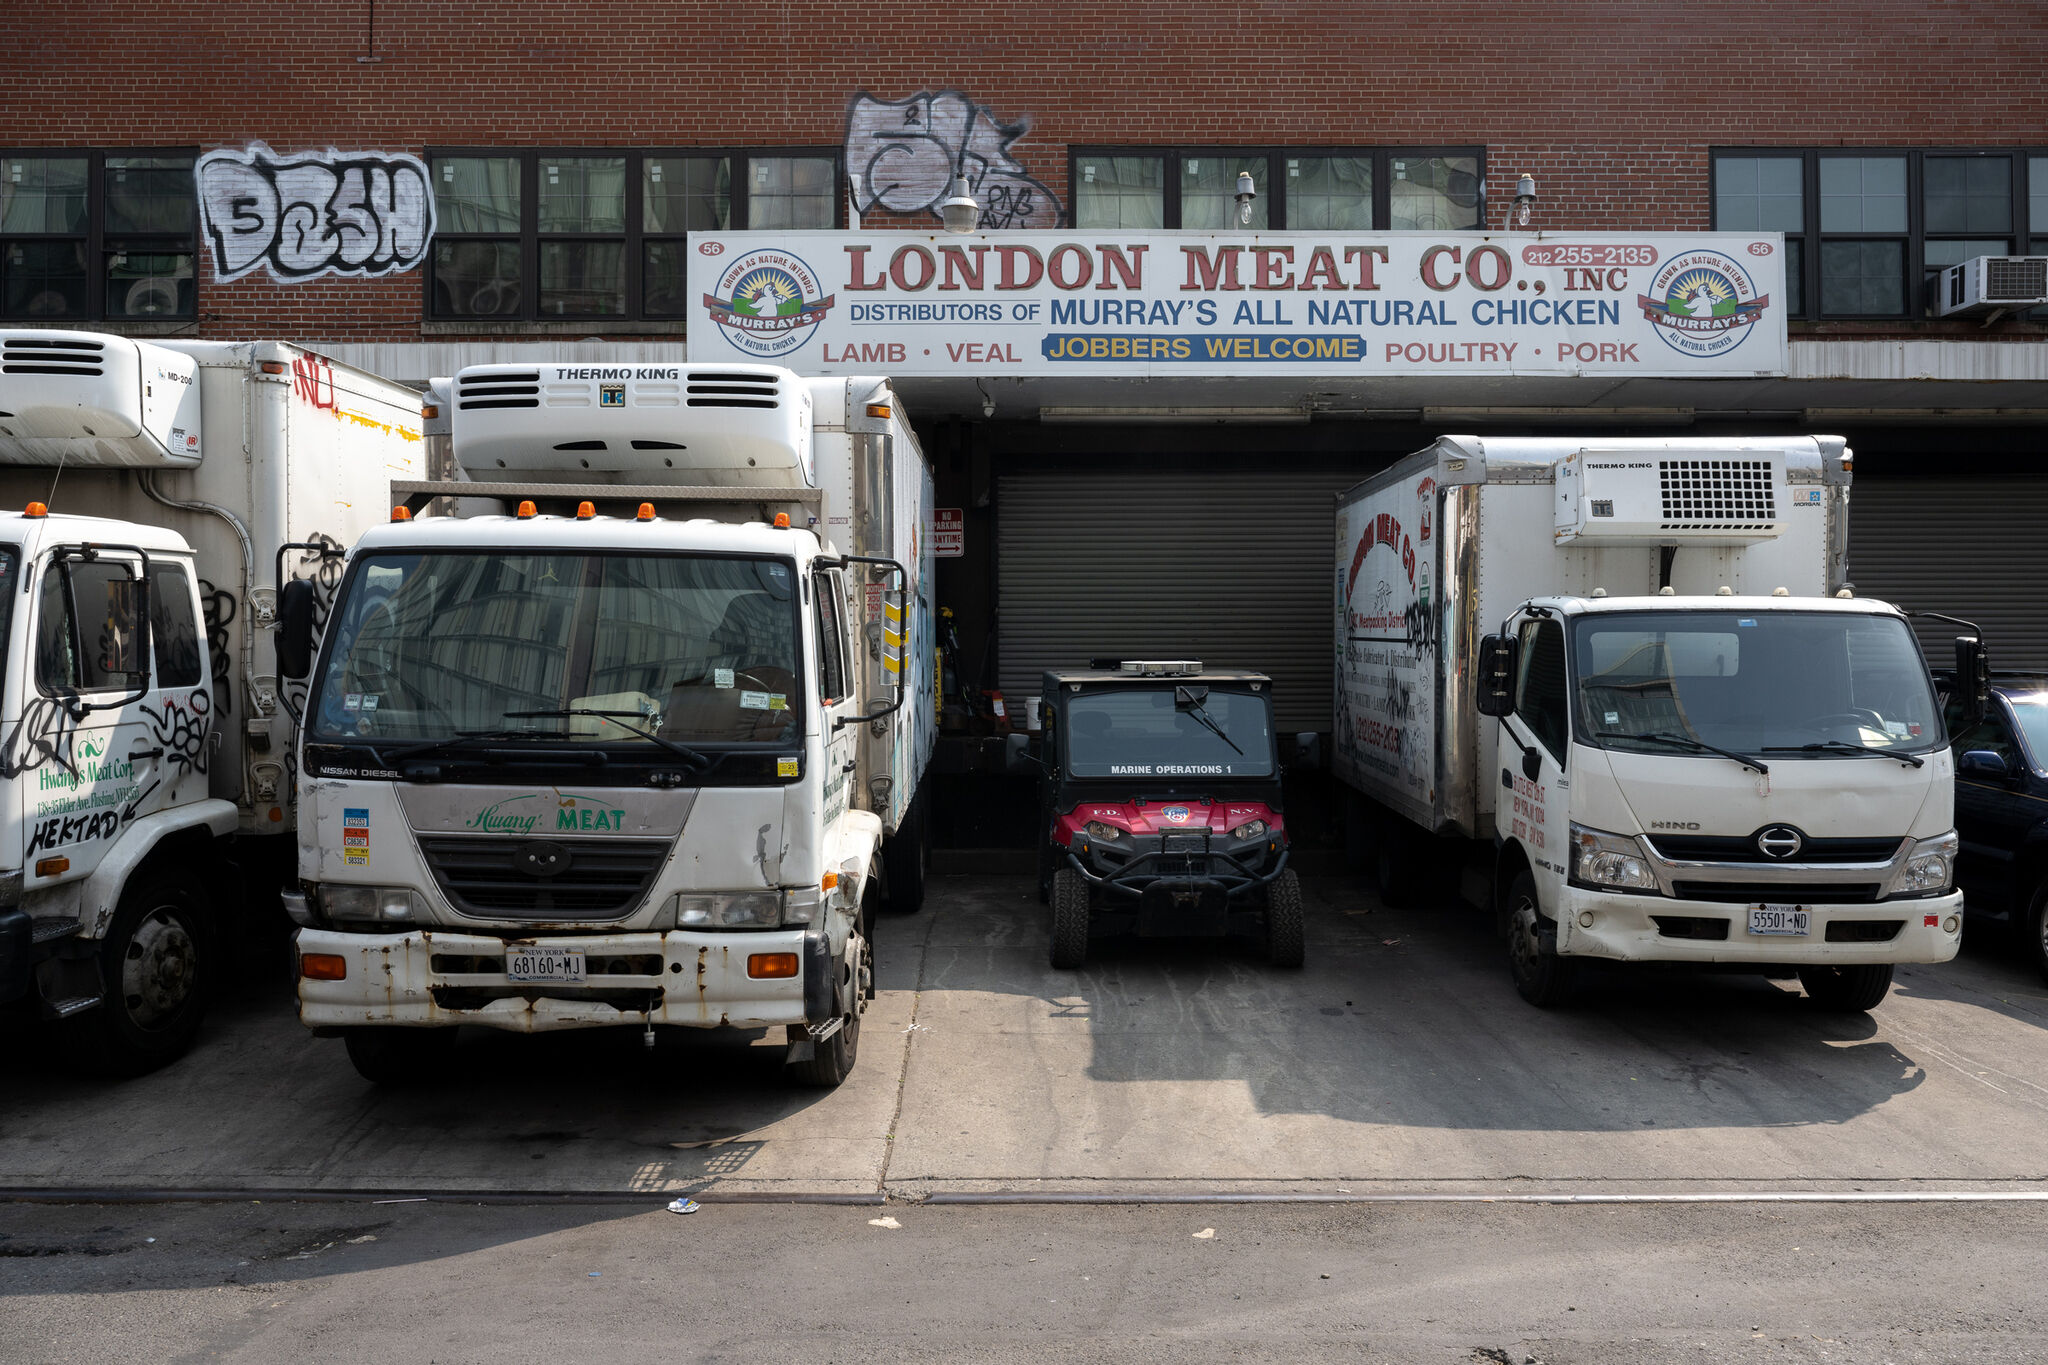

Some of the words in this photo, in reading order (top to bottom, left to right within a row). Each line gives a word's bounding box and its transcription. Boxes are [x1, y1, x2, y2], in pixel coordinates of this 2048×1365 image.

[703, 244, 721, 254] 56
[1528, 252, 1552, 264] 212
[1554, 247, 1652, 264] 255-2135
[1752, 244, 1769, 255] 56
[723, 264, 745, 290] GROWN
[746, 258, 756, 269] AS
[758, 255, 788, 267] NATURE
[788, 262, 815, 295] INTENDED
[843, 244, 1149, 292] LONDON
[1179, 244, 1389, 292] MEAT
[1563, 267, 1628, 292] INC
[1657, 264, 1679, 290] GROWN
[1679, 258, 1690, 269] AS
[1691, 256, 1721, 268] NATURE
[1722, 263, 1749, 296] INTENDED
[727, 313, 813, 330] MURRAY'S
[850, 303, 1003, 321] DISTRIBUTORS
[1012, 303, 1038, 321] OF
[1050, 299, 1217, 326] MURRAY'S
[1233, 300, 1293, 325] ALL
[1308, 299, 1457, 326] NATURAL
[1471, 299, 1620, 326] CHICKEN
[1662, 313, 1748, 330] MURRAY'S
[734, 332, 744, 343] ALL
[744, 338, 771, 352] NATURAL
[772, 335, 797, 351] CHICKEN
[1049, 337, 1191, 358] JOBBERS
[1205, 338, 1359, 358] WELCOME
[1669, 332, 1679, 343] ALL
[1679, 338, 1707, 352] NATURAL
[1707, 335, 1733, 351] CHICKEN
[823, 343, 906, 362] LAMB
[946, 343, 1021, 362] VEAL
[1386, 343, 1517, 362] POULTRY
[1558, 343, 1639, 362] PORK
[167, 371, 193, 386] MD-200
[556, 368, 633, 380] THERMO
[635, 368, 679, 380] KING
[942, 511, 952, 521] NO
[1376, 512, 1401, 554] MEAT
[86, 760, 113, 783] Meat
[320, 766, 358, 776] NISSAN
[360, 769, 404, 779] DIESEL
[1110, 765, 1152, 774] MARINE
[1155, 765, 1222, 774] OPERATIONS
[1226, 765, 1232, 774] 1
[556, 808, 626, 831] MEAT
[1651, 820, 1701, 831] HINO
[26, 810, 119, 858] HEKTAD
[1754, 911, 1785, 928] 55501
[1794, 913, 1807, 929] ND
[514, 956, 555, 974] 68160
[563, 957, 580, 974] MJ
